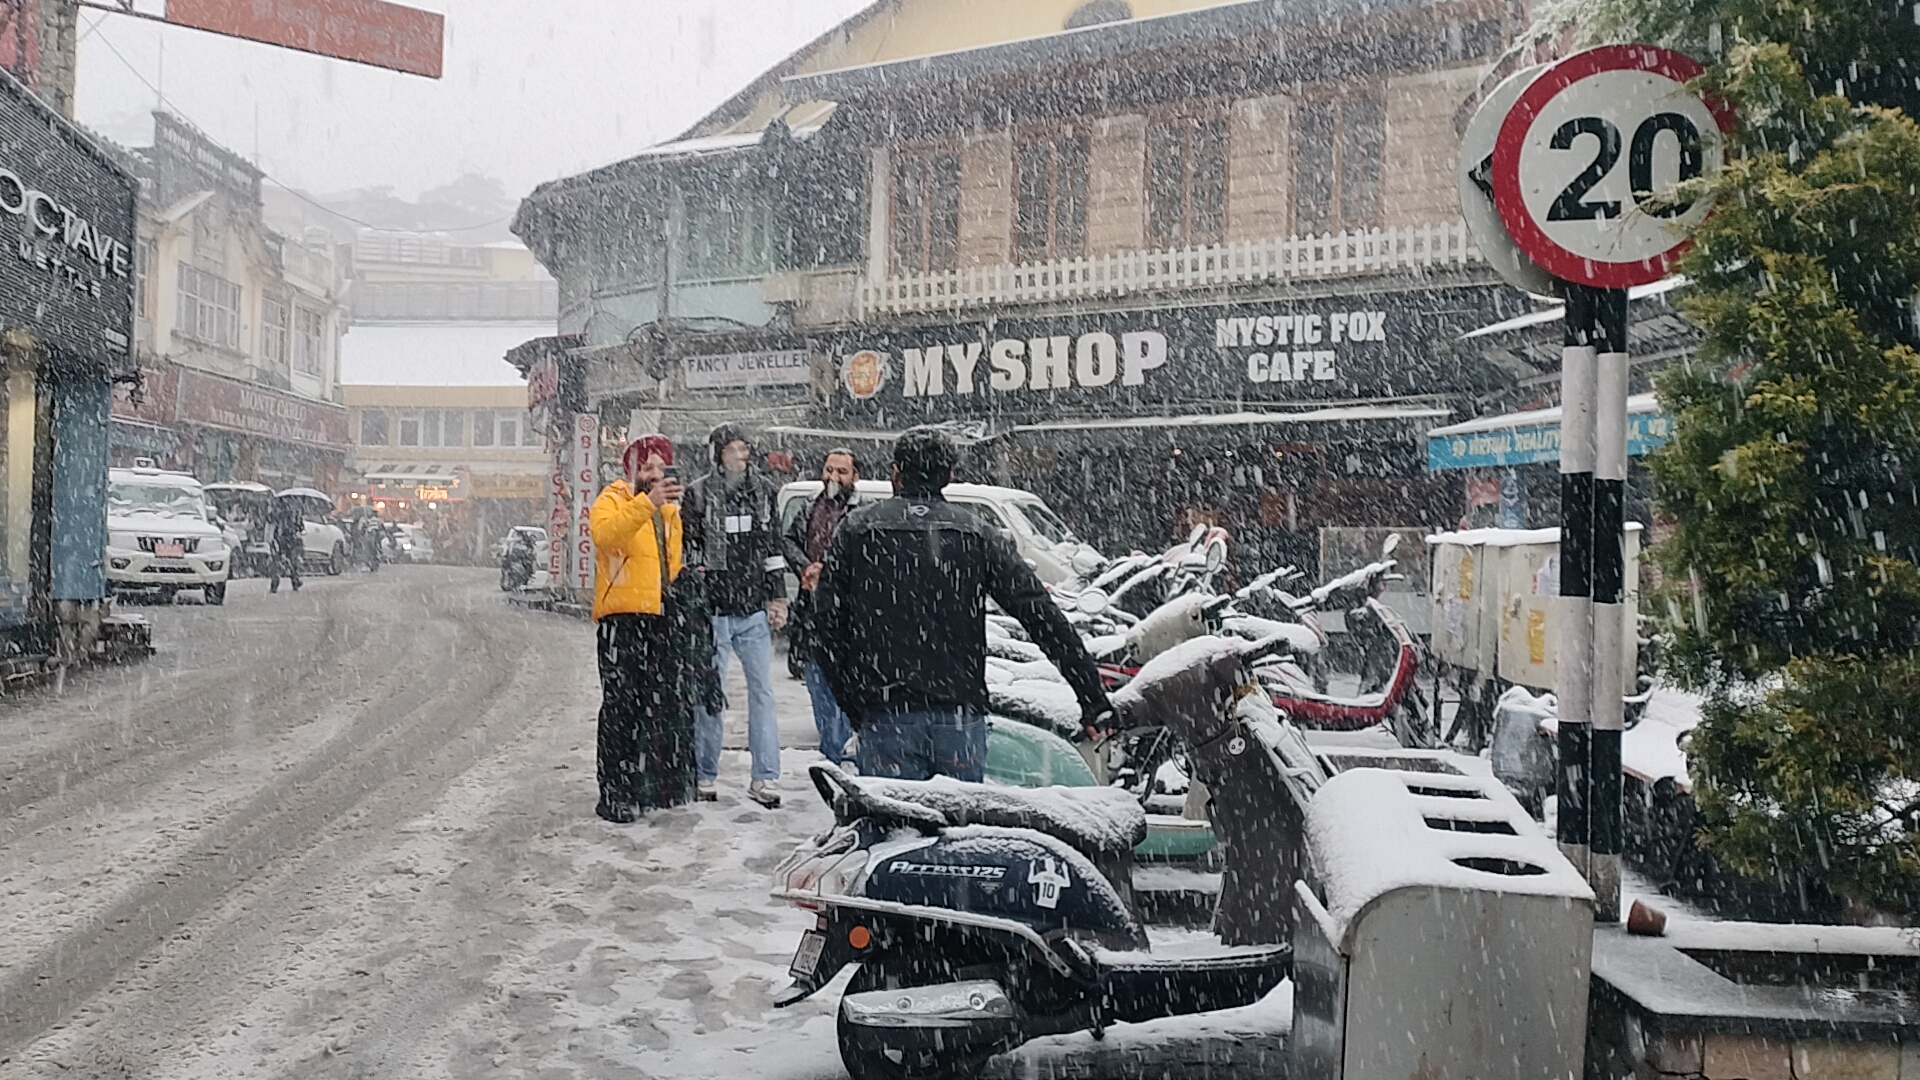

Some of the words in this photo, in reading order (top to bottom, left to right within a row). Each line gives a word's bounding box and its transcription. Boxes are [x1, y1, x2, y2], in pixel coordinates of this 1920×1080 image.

[1547, 112, 1703, 222] 20
[1215, 315, 1322, 348] MYSTIC
[1331, 311, 1387, 343] FOX
[687, 355, 731, 373] FANCY
[1248, 349, 1336, 383] CAFE
[579, 435, 593, 484] BIG
[578, 489, 592, 589] TARGET
[1042, 882, 1056, 899] 10
